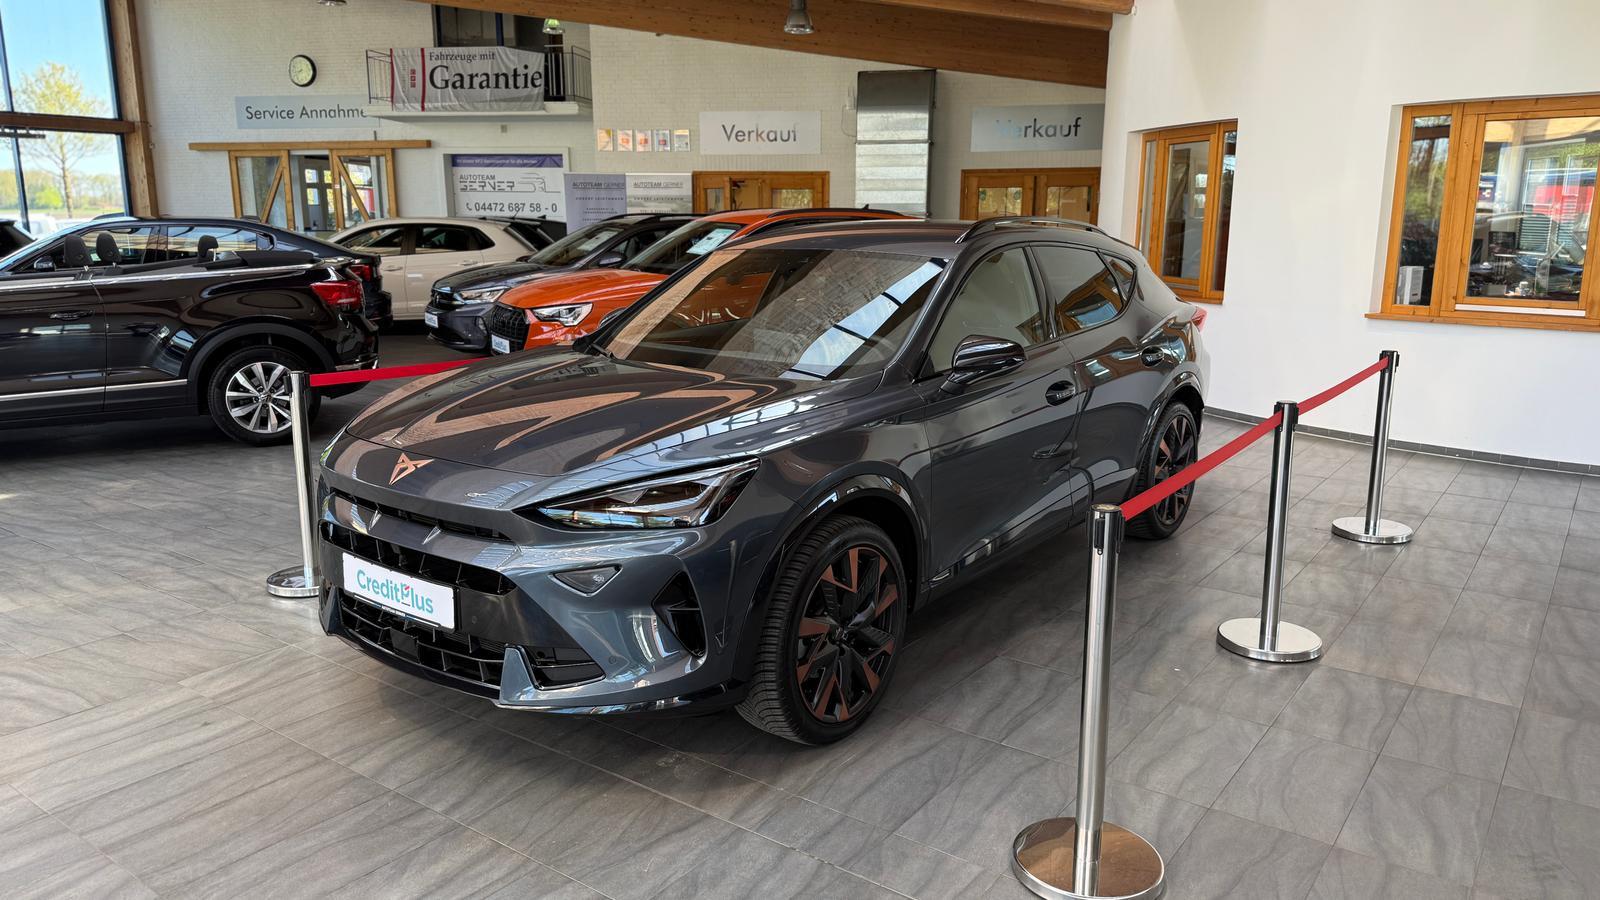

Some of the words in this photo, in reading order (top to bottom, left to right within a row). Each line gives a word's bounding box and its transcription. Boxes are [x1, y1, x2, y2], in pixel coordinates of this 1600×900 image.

[429, 52, 476, 63] Fahrzeuge
[479, 52, 496, 61] mit
[429, 64, 543, 90] Garantie
[245, 105, 295, 120] Service
[474, 202, 505, 212] 04472
[508, 202, 526, 212] 687
[530, 203, 541, 213] 58
[551, 203, 558, 213] 0
[356, 569, 434, 615] CreditPlus
